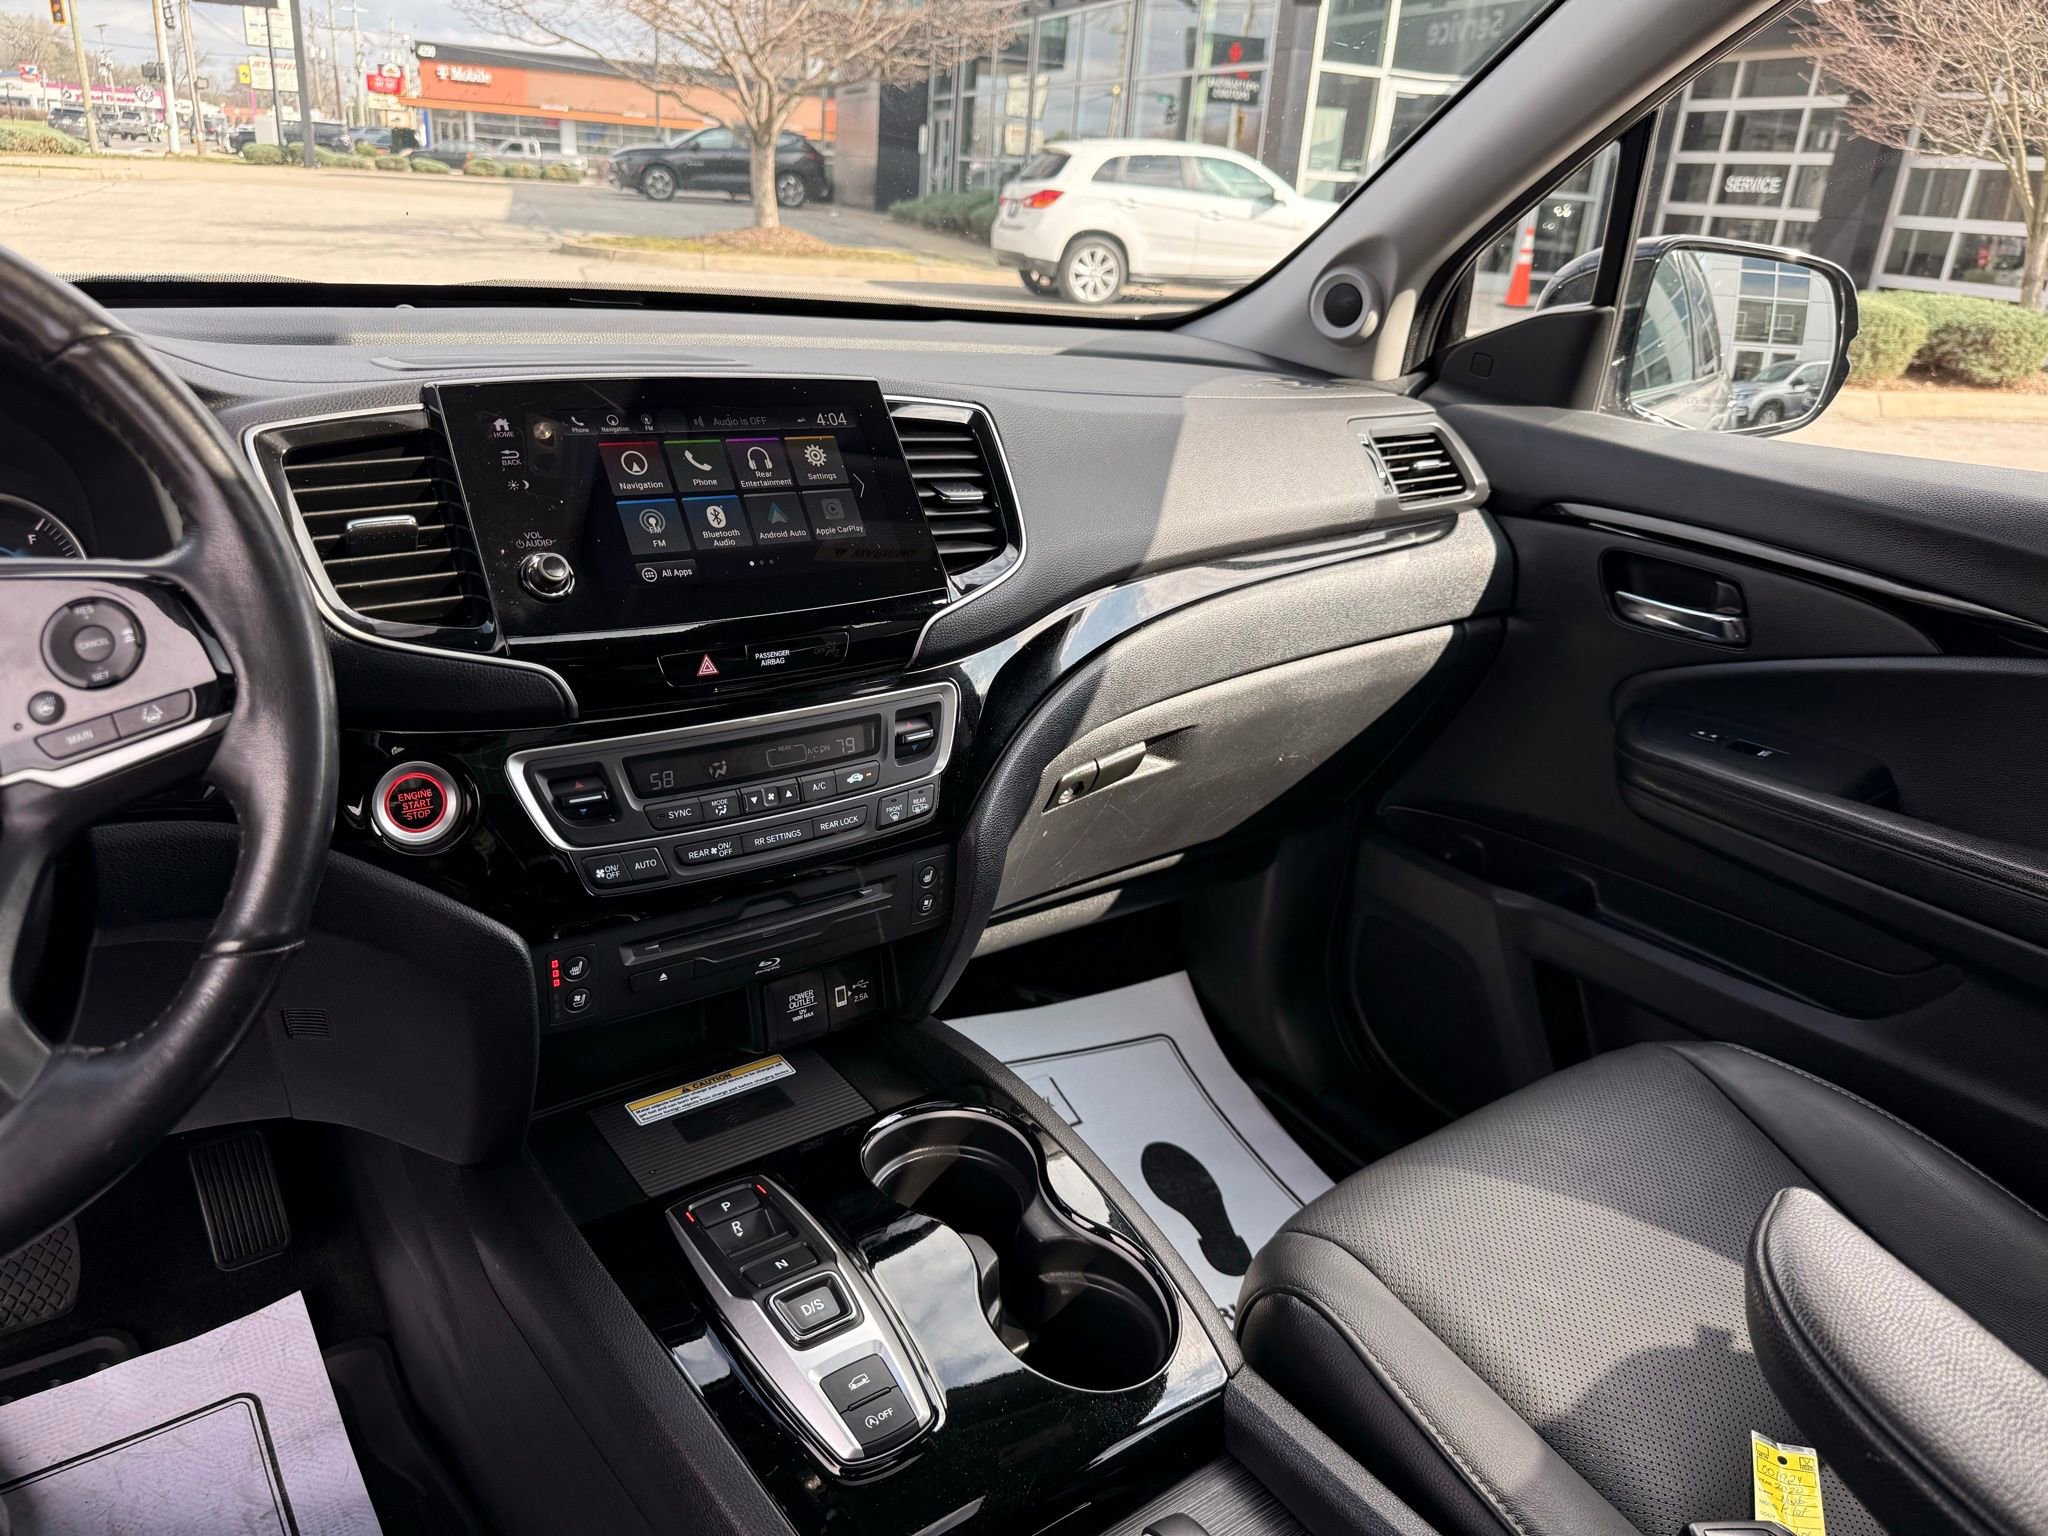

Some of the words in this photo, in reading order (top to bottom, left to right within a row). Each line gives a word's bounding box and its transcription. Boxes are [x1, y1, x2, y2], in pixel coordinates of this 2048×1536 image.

[1725, 174, 1782, 193] SERVICE
[713, 416, 738, 426] Audio
[749, 416, 767, 425] OFF
[816, 412, 847, 426] 4:04
[755, 470, 772, 478] Rear
[807, 471, 837, 481] Settings
[619, 481, 664, 490] Navigation
[692, 478, 718, 486] Phone
[740, 478, 792, 488] Entertainment
[523, 531, 543, 539] VOL
[702, 528, 740, 539] Bluetooth
[759, 530, 788, 540] Android
[789, 529, 807, 538] Auto
[816, 526, 837, 535] Apple
[837, 524, 864, 534] CarPlay
[27, 534, 37, 545] F
[525, 538, 553, 548] AUDIO
[652, 539, 666, 548] FM
[713, 538, 736, 547] Audio
[662, 569, 673, 578] All
[673, 568, 693, 578] Apps
[75, 605, 95, 616] RES
[79, 637, 110, 650] CANCEL
[755, 649, 790, 660] PASSENGER
[760, 657, 785, 667] AIRBAG
[91, 671, 109, 682] SET
[66, 729, 94, 745] MAIN
[835, 737, 856, 754] 79
[650, 770, 674, 790] 58
[812, 782, 826, 791] A/C
[397, 788, 433, 802] ENGINE
[402, 799, 431, 811] START
[711, 798, 728, 807] MODE
[668, 808, 693, 819] SYNC
[886, 804, 903, 813] FRONT
[406, 809, 431, 821] STOP
[820, 819, 839, 831] REAR
[839, 815, 859, 826] LOCK
[754, 835, 765, 846] RR
[766, 829, 802, 845] SETTINGS
[688, 849, 709, 860] REAR
[717, 842, 732, 850] ON/
[718, 848, 733, 857] OFF
[604, 864, 619, 873] ON/
[634, 859, 657, 871] AUTO
[606, 870, 620, 880] OFF
[789, 989, 814, 1002] POWER
[854, 993, 868, 1002] 2.5A
[788, 996, 815, 1009] OUTLET
[692, 1073, 731, 1088] CAUTION
[720, 1201, 731, 1213] P
[731, 1221, 743, 1232] R
[775, 1258, 788, 1269] N
[801, 1298, 825, 1316] D/S
[878, 1407, 894, 1421] OFF
